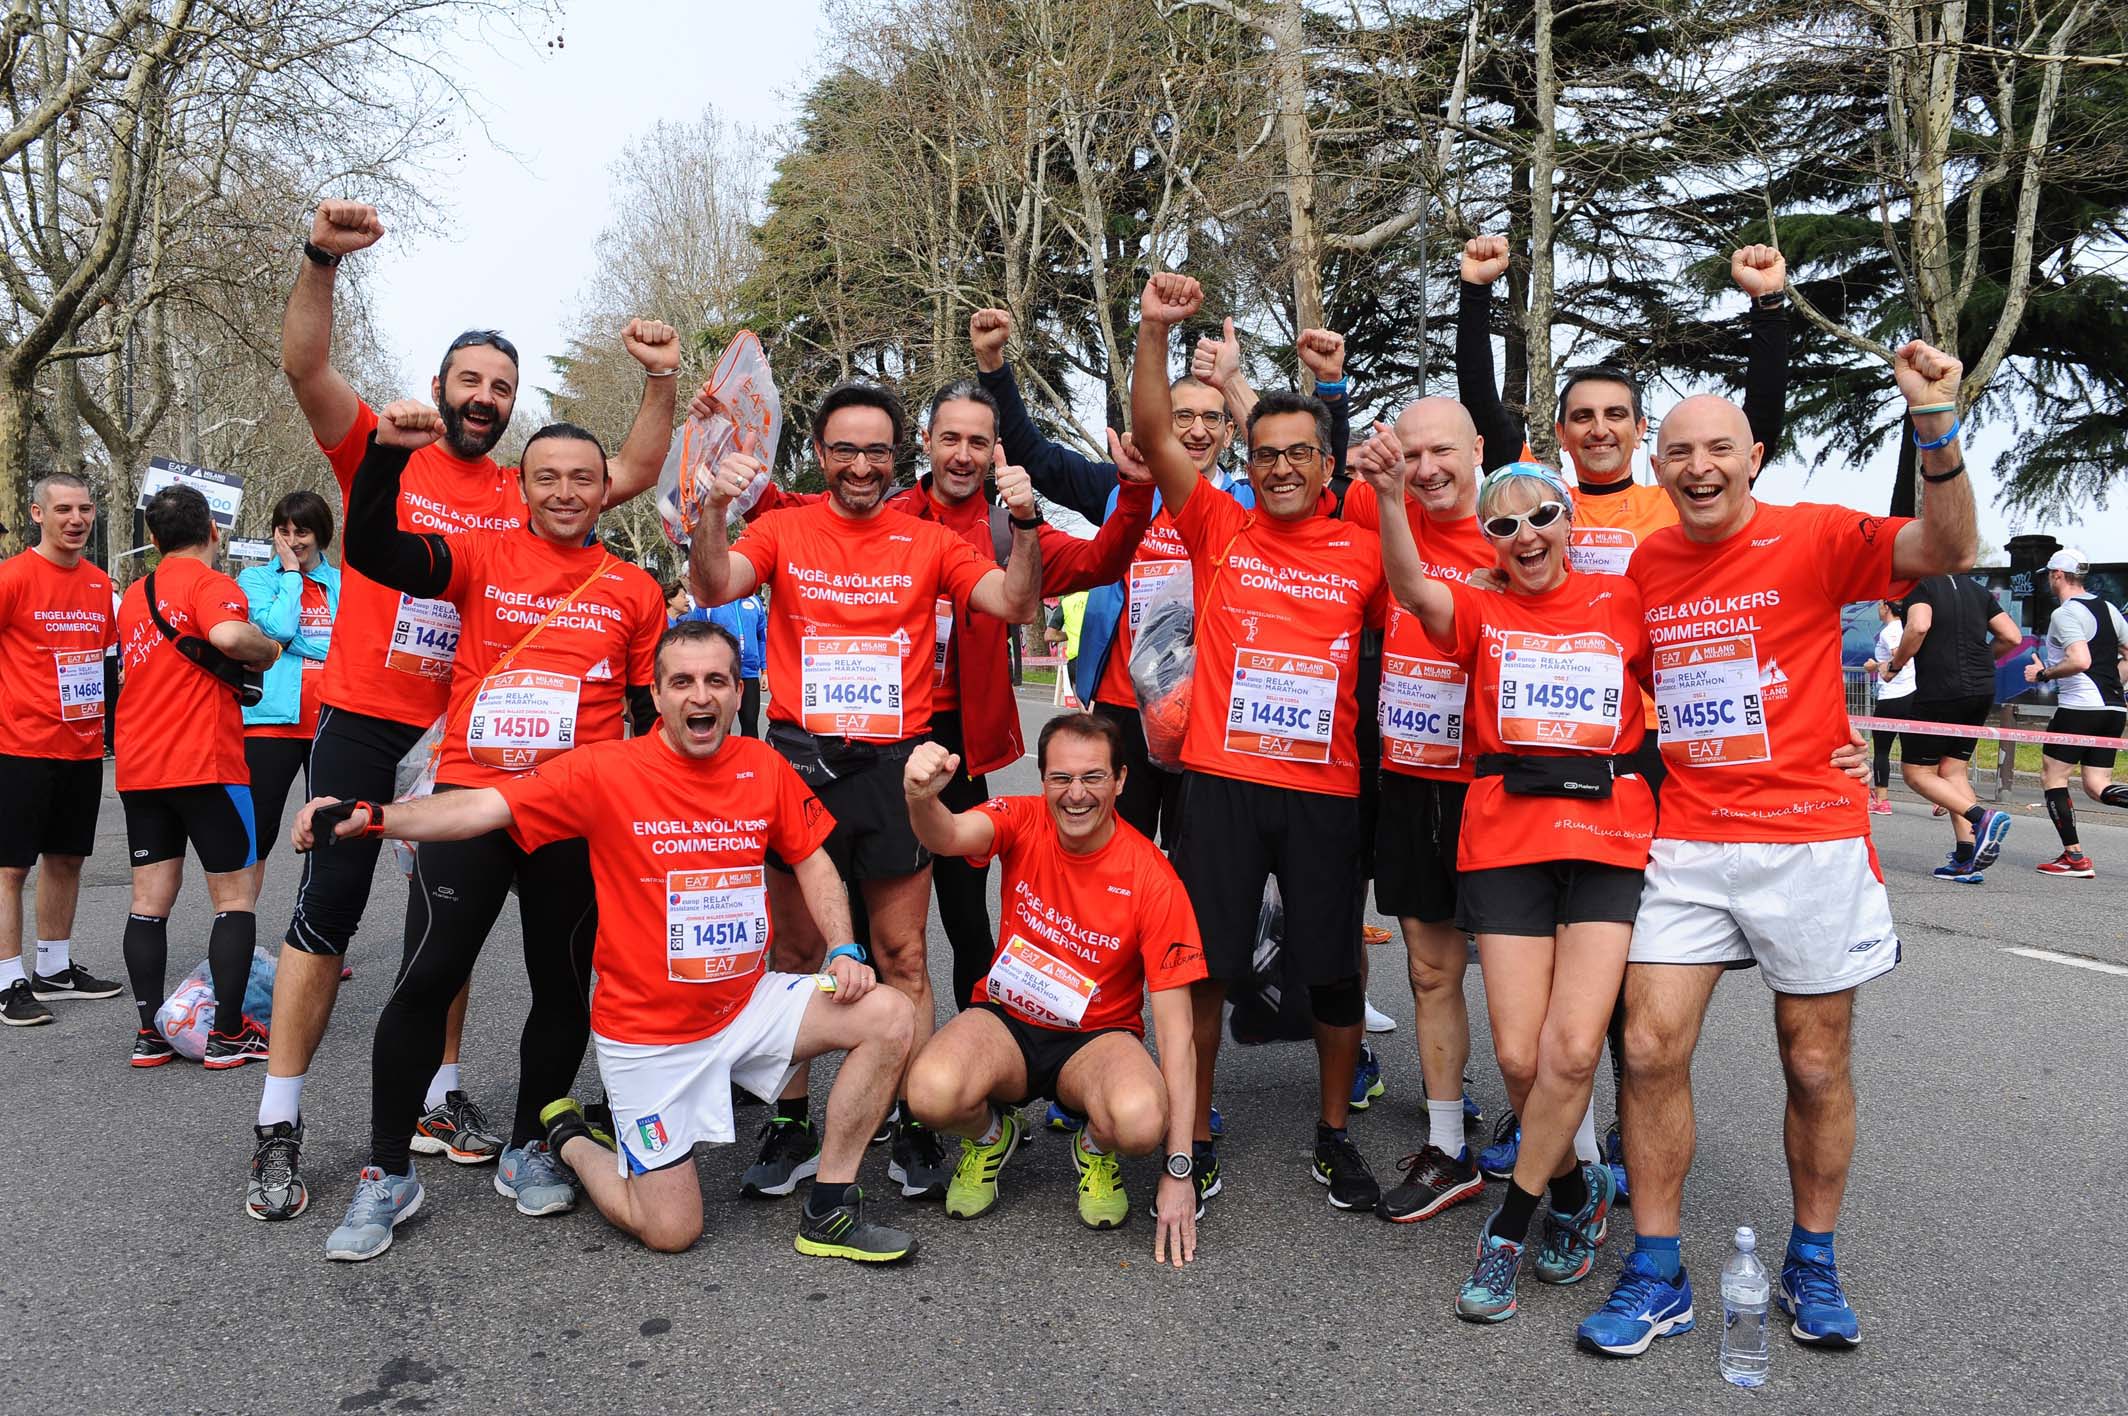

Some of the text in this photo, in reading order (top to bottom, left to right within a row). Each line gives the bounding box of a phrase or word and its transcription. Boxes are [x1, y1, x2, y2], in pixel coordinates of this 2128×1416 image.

[168, 462, 187, 473] EA7
[1595, 533, 1623, 541] MILANO
[1143, 566, 1162, 576] EA7
[1240, 573, 1348, 604] COMMERCIAL
[799, 585, 899, 605] COMMERCIAL
[432, 604, 457, 616] RELA
[1645, 589, 1780, 623] GEL&VÖLKERS
[1650, 615, 1762, 644] COMMERCIAL
[817, 642, 840, 651] EA7
[861, 641, 887, 649] MILANO
[1523, 638, 1549, 649] EA7
[1574, 639, 1606, 647] MILANO
[1703, 644, 1735, 656] MILANO
[67, 655, 82, 664] EA7
[1251, 655, 1275, 667] EA7
[1540, 657, 1575, 665] RELAY
[1661, 651, 1681, 663] EA7
[1296, 661, 1324, 672] MILANO
[1387, 659, 1405, 670] EA7
[1423, 666, 1452, 675] MILANO
[1540, 663, 1591, 673] MARATHON
[493, 675, 516, 686] EA7
[536, 675, 565, 685] MILANO
[1265, 676, 1295, 686] RELAY
[1677, 670, 1708, 681] RELAY
[1397, 681, 1423, 691] RELAY
[1679, 677, 1725, 689] MARATHON
[73, 682, 103, 698] 1468C
[823, 683, 883, 704] 1464C
[1265, 684, 1309, 695] MARATHON
[1397, 688, 1437, 700] MARATHON
[1761, 686, 1788, 697] ILANO
[505, 692, 535, 700] RELAY
[1525, 683, 1596, 711] 1459C
[81, 703, 99, 714] EA7
[1673, 699, 1736, 729] 1455C
[836, 714, 870, 728] EA7
[1251, 702, 1312, 730] 1443C
[1387, 706, 1441, 734] 1449C
[493, 717, 550, 738] 1451D
[1537, 721, 1579, 738] EA7
[1258, 735, 1295, 752] EA7
[1392, 740, 1425, 757] EA7
[1688, 739, 1724, 757] EA7
[502, 749, 539, 763] EA7
[652, 836, 761, 855] COMMERCIAL
[685, 876, 710, 887] EA7
[729, 873, 752, 882] MILANO
[703, 895, 731, 904] RELAY
[703, 902, 743, 911] MARATHON
[693, 921, 749, 946] 1451A
[1016, 902, 1101, 964] COMMERCIAL
[1020, 948, 1040, 963] EA7
[705, 956, 736, 972] EA7
[1023, 971, 1050, 989] RELAY
[1055, 967, 1081, 987] MILANO
[1021, 978, 1058, 1002] MARATHON
[1006, 988, 1060, 1021] 1467D
